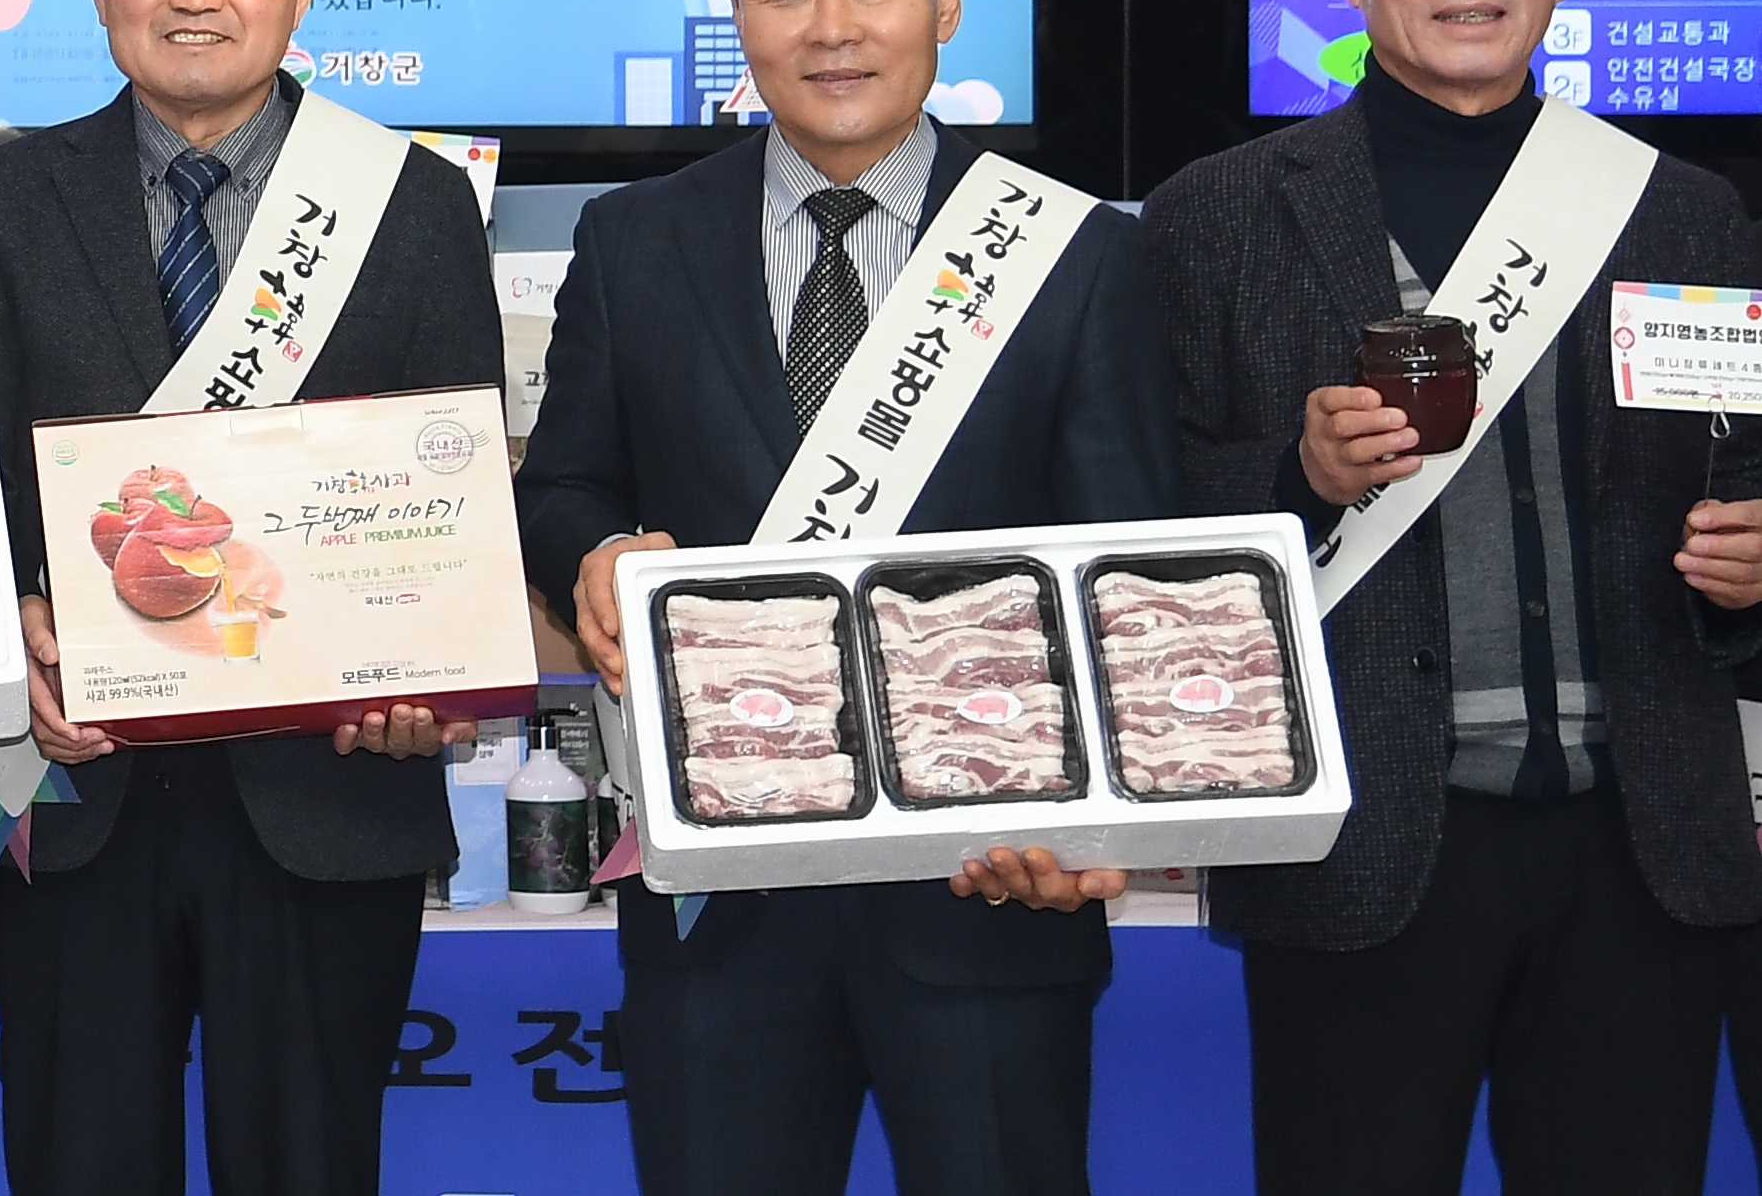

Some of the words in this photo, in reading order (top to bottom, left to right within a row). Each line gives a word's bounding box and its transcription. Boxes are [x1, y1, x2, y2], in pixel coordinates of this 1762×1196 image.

[1552, 22, 1584, 50] 3F
[1607, 20, 1730, 46] 건설교통과
[325, 53, 423, 83] 거창군
[1607, 86, 1680, 111] 수유실
[857, 326, 952, 452] 쇼핑몰
[387, 496, 465, 520] 이야기
[320, 532, 358, 547] APPLE
[364, 595, 394, 606] 국내산
[341, 667, 402, 685] 모든푸드
[405, 669, 442, 679] Modern
[444, 666, 466, 676] food
[85, 688, 106, 704] 사과
